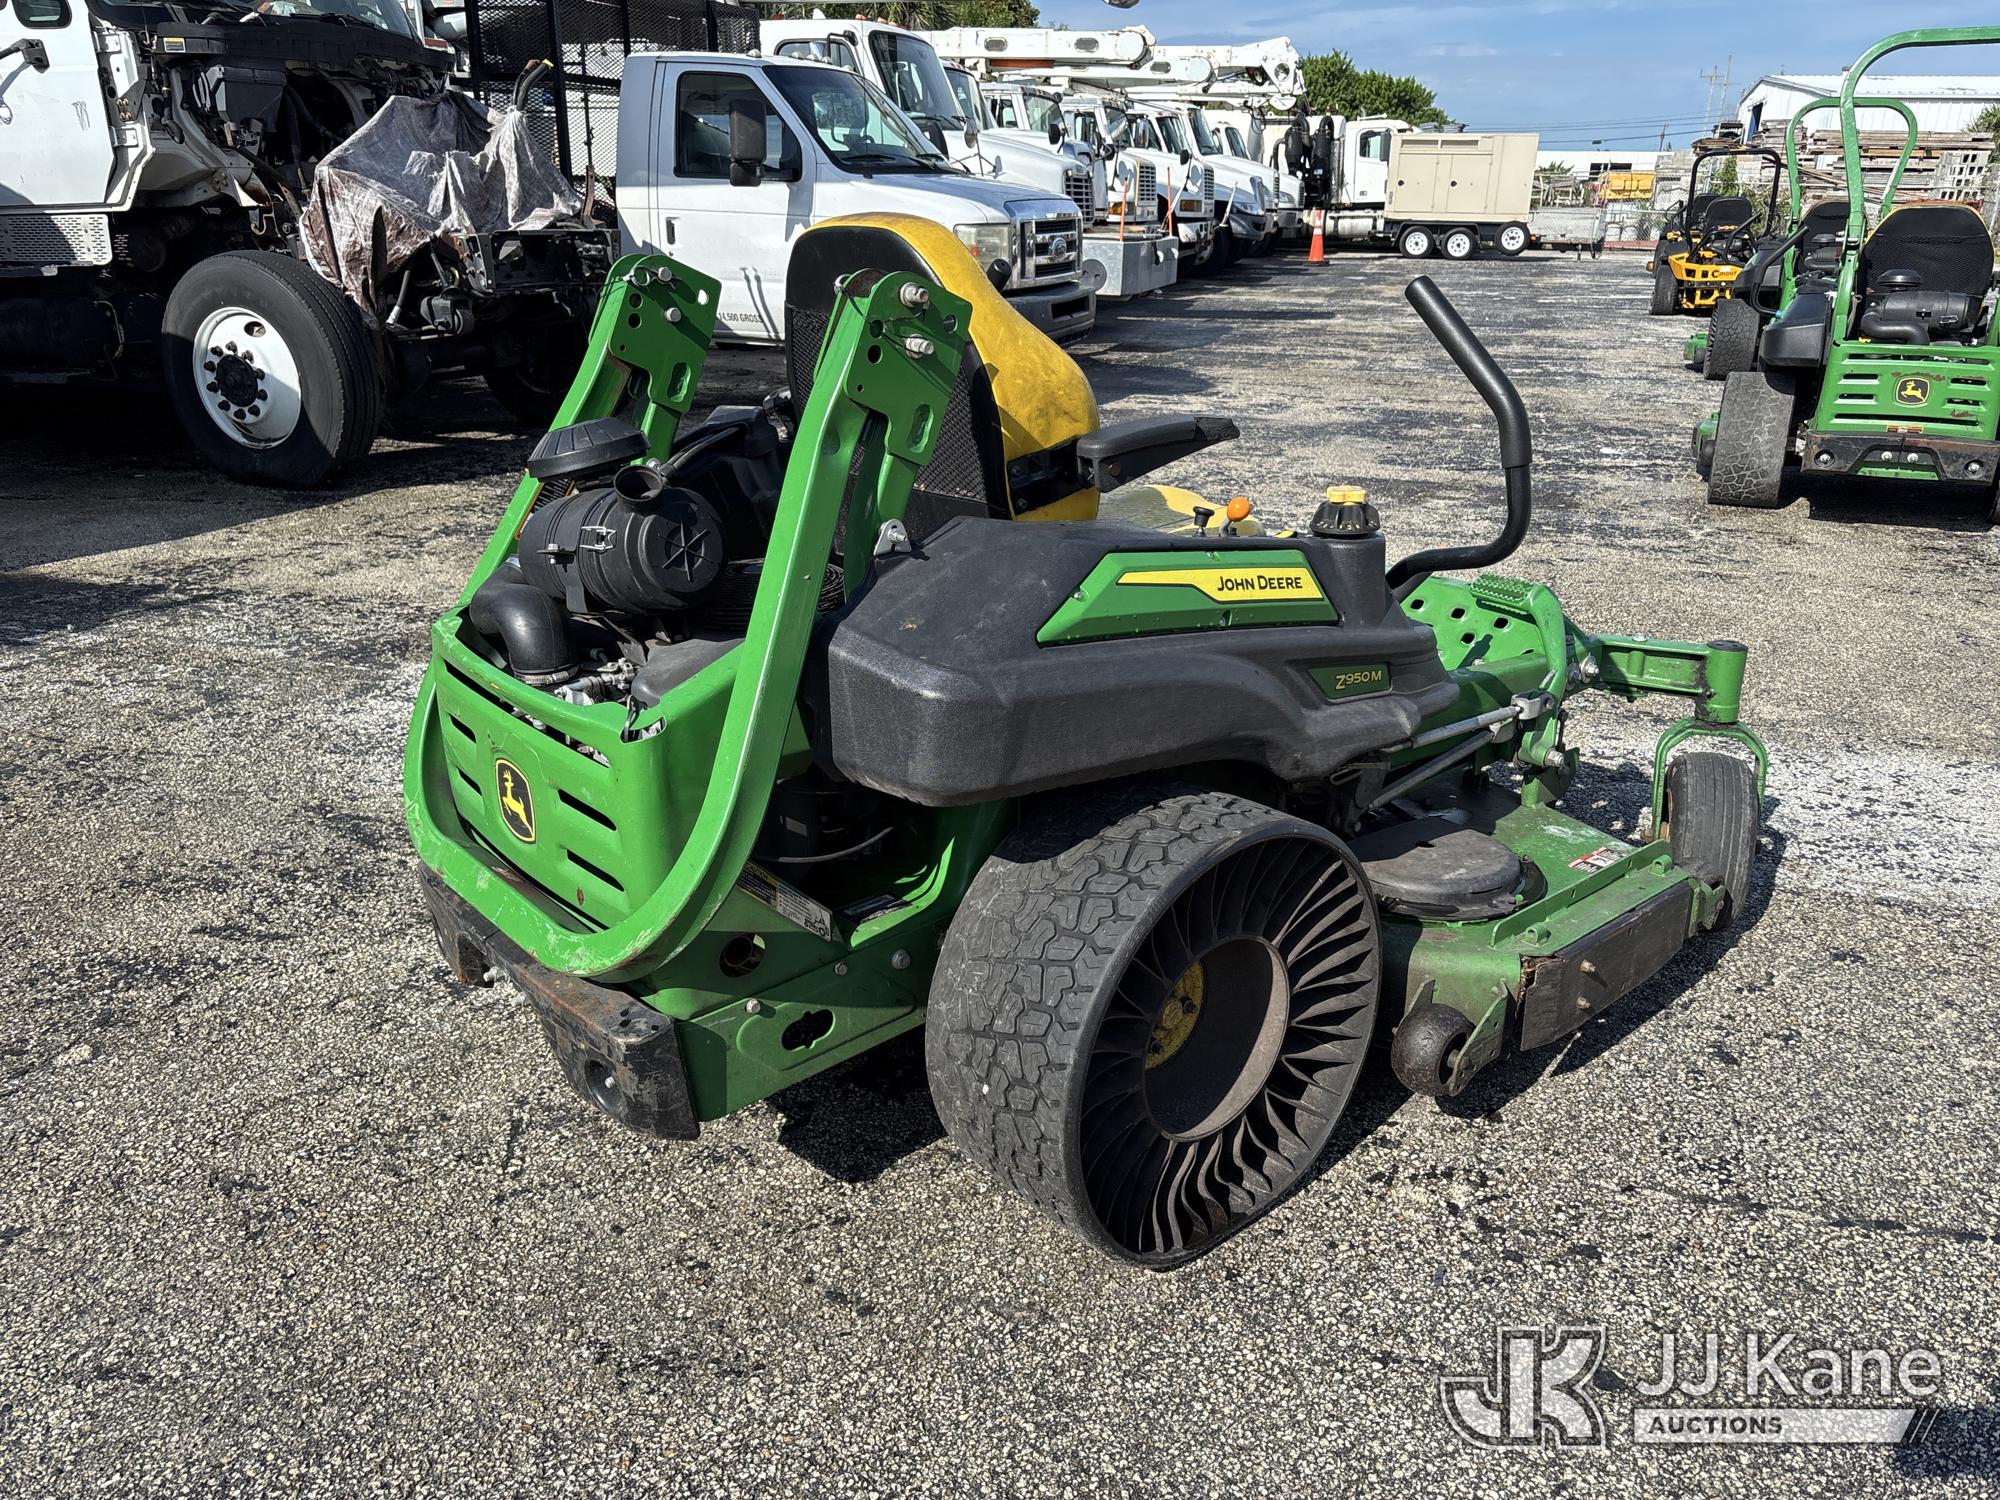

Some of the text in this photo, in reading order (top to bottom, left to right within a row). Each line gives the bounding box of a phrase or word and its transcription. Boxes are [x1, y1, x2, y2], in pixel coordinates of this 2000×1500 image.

[1217, 575, 1303, 592] JOHN DEERE
[1335, 670, 1382, 689] Z950M
